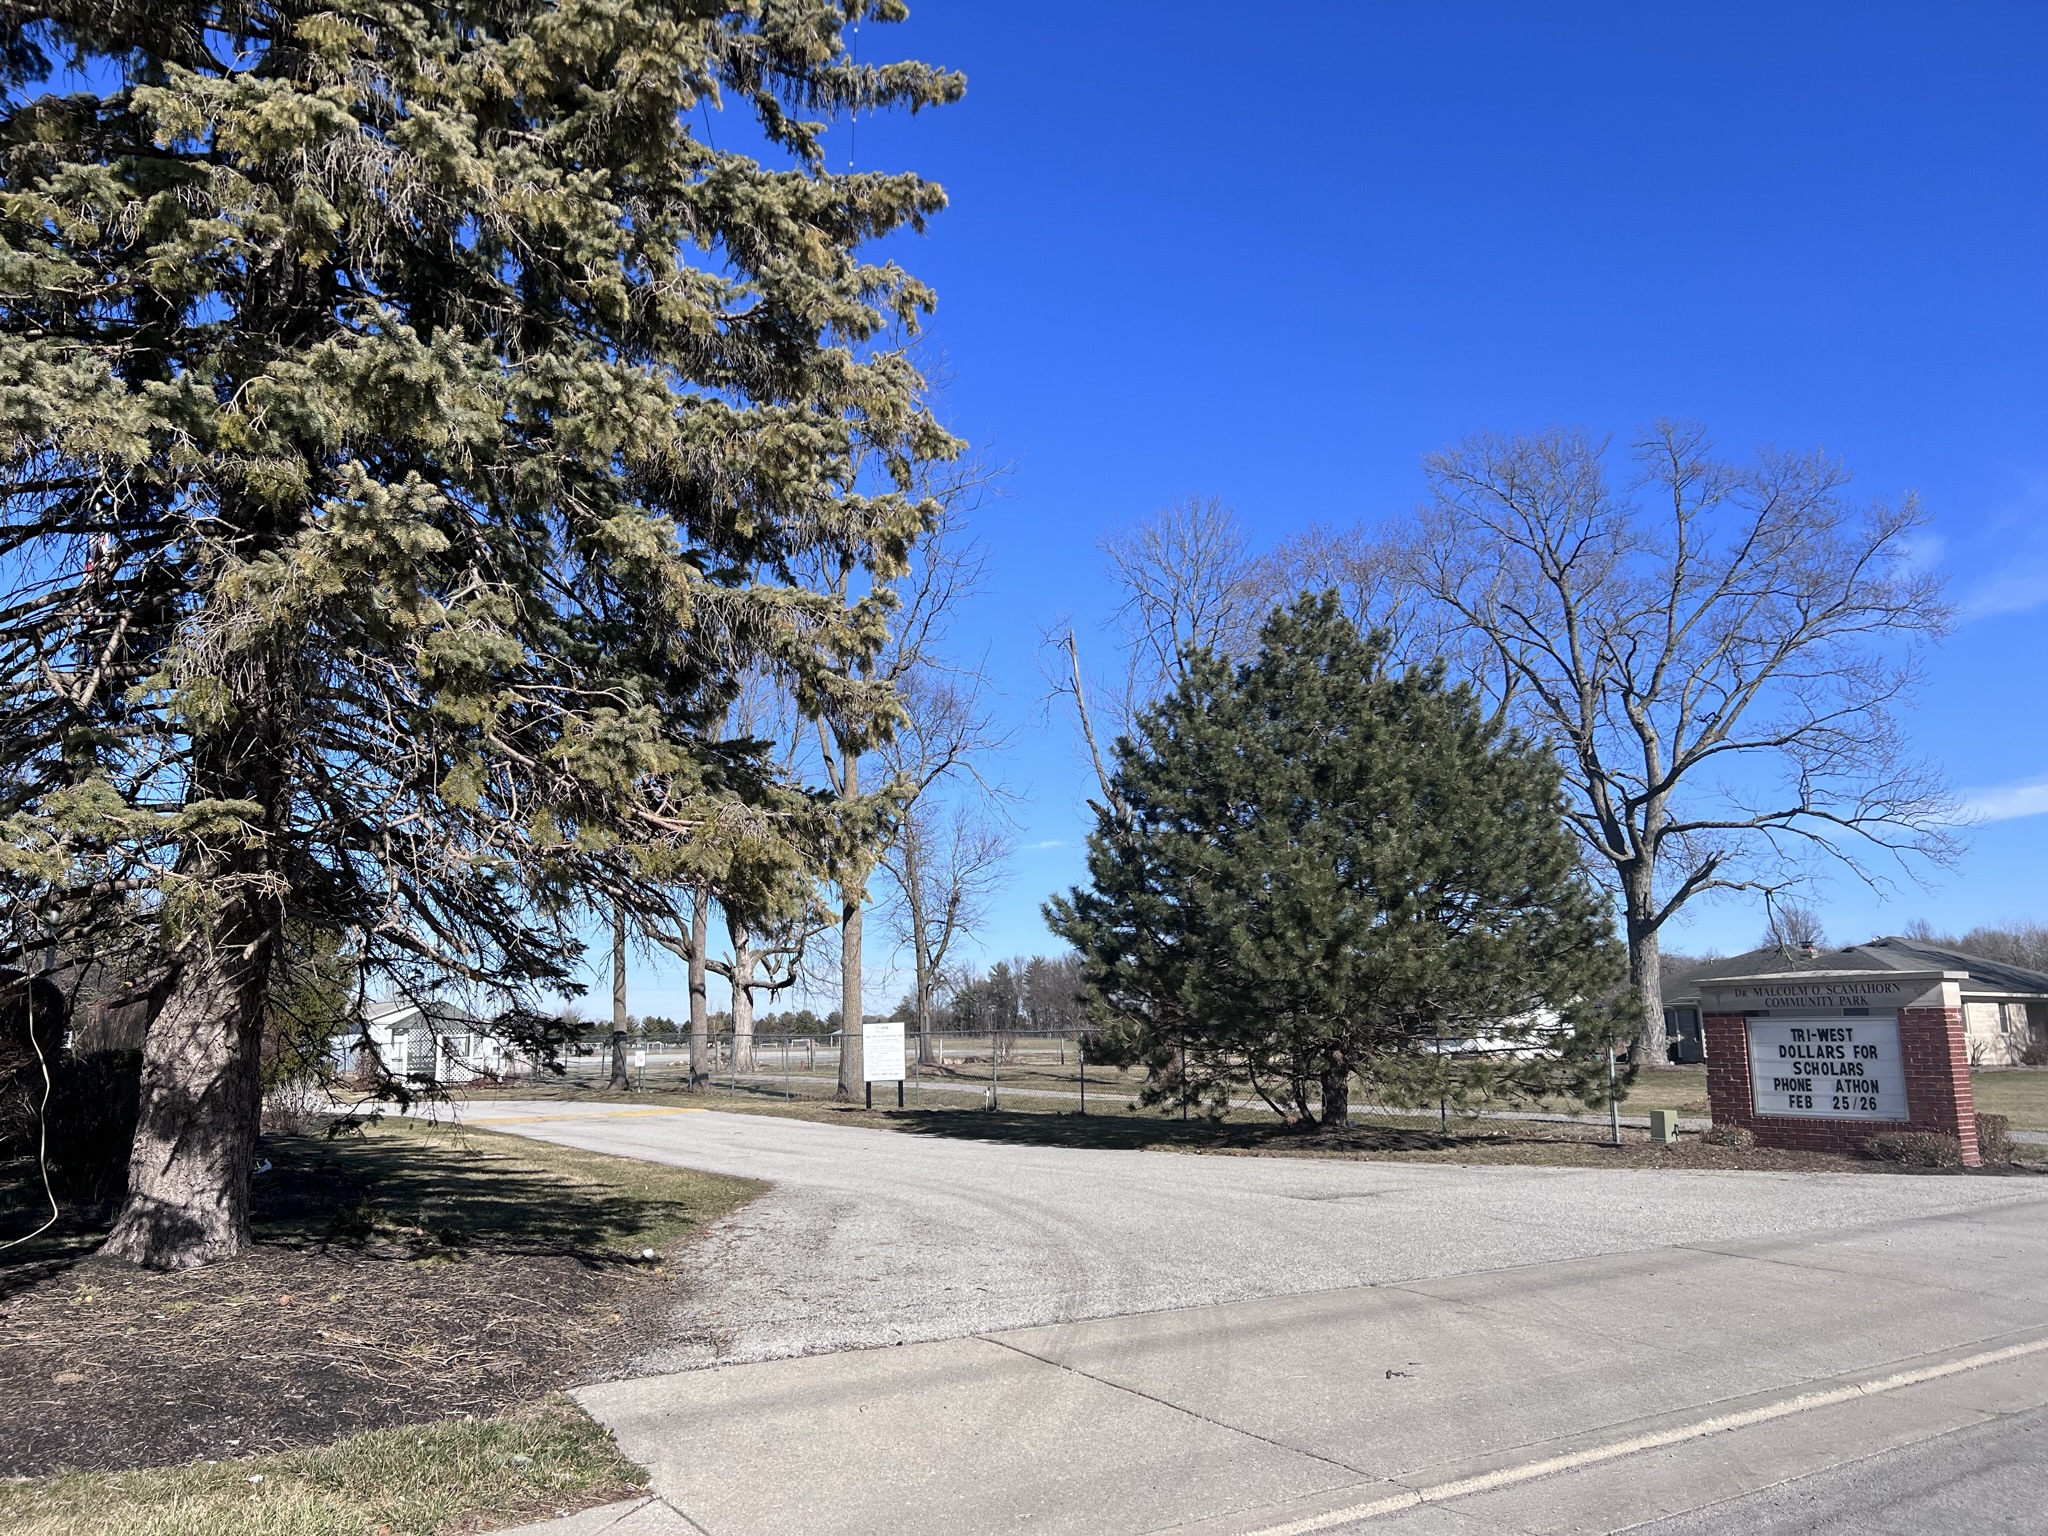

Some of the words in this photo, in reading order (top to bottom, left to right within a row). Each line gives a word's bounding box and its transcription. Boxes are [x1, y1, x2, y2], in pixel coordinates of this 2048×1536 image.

[1753, 985, 1808, 997] MALCOLM
[1826, 983, 1901, 995] SCAMAHORN
[1765, 997, 1833, 1008] COMMUNITY
[1839, 995, 1869, 1006] PARK
[1790, 1028, 1853, 1042] TRI-WEST
[1779, 1045, 1845, 1059] DOLLARS
[1853, 1045, 1878, 1059] FOR
[1793, 1061, 1864, 1076] SCHOLARS
[1773, 1078, 1813, 1092] PHONE
[1835, 1079, 1879, 1094] ATHON
[1789, 1095, 1812, 1109] FEB
[1832, 1096, 1877, 1110] 25/26
